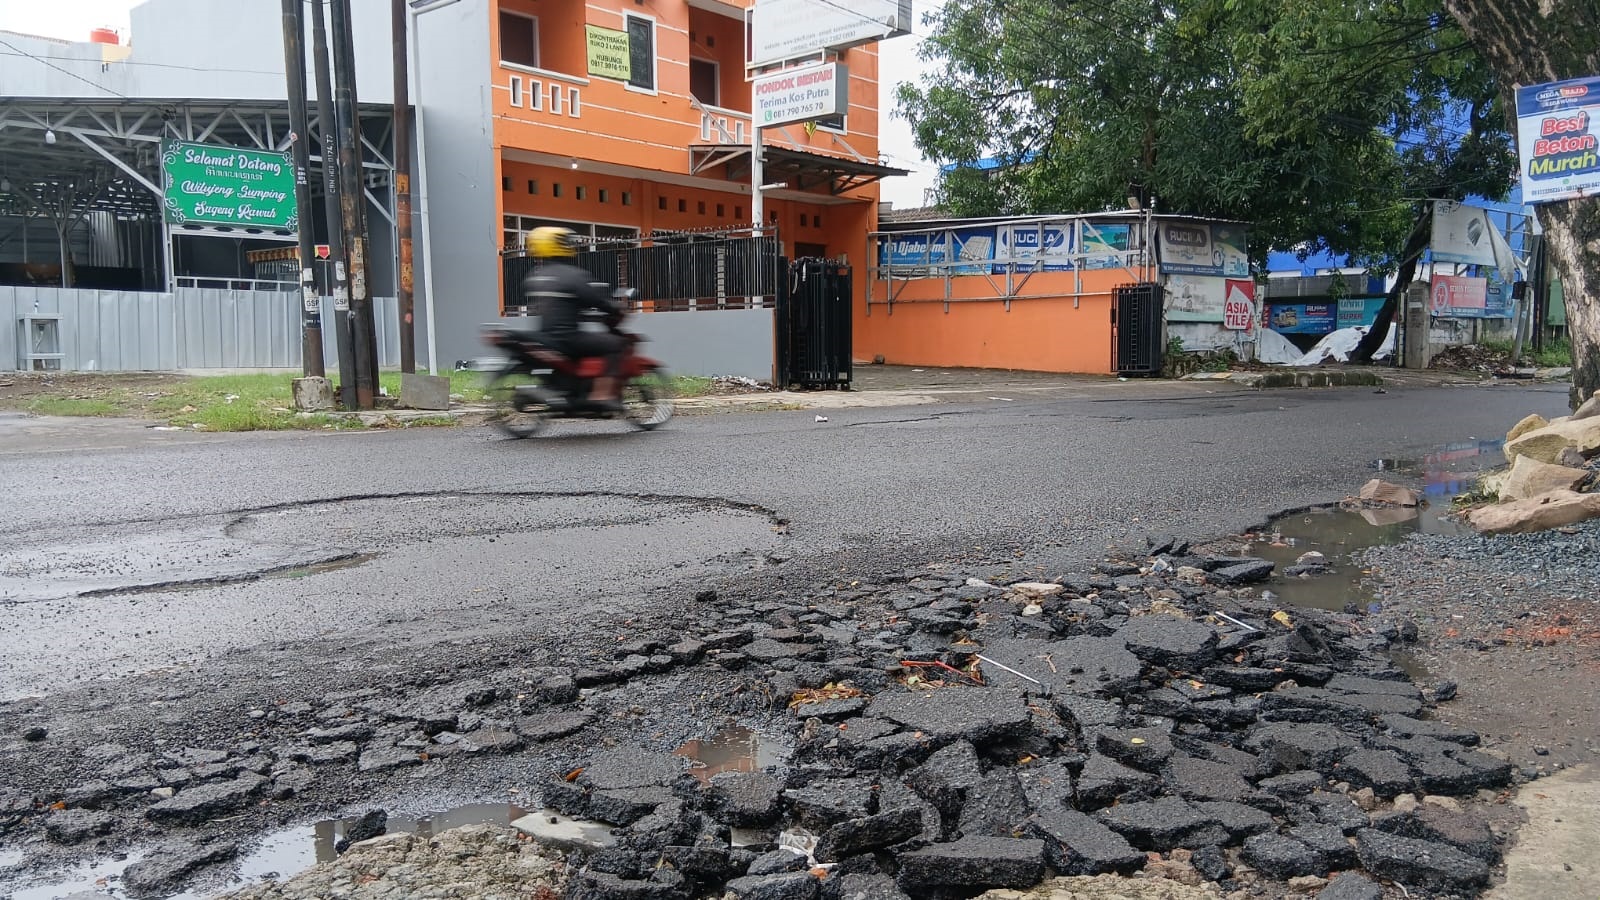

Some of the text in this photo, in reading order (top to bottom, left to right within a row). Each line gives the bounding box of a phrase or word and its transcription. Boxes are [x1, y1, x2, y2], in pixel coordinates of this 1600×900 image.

[756, 69, 833, 96] PONDOK BESTARI
[760, 88, 829, 109] Terima Kos Putra
[1539, 90, 1560, 99] MEGA
[815, 102, 824, 110] 70
[1542, 111, 1586, 136] Besi
[1534, 134, 1595, 157] Beton
[185, 149, 235, 168] Selamat
[238, 154, 281, 176] Datang
[1529, 152, 1597, 176] Murah
[181, 180, 287, 202] Wilujeng Sumping
[194, 201, 277, 220] Sugeng Rawuh
[1226, 302, 1249, 314] ASIA
[1225, 314, 1247, 326] TILE
